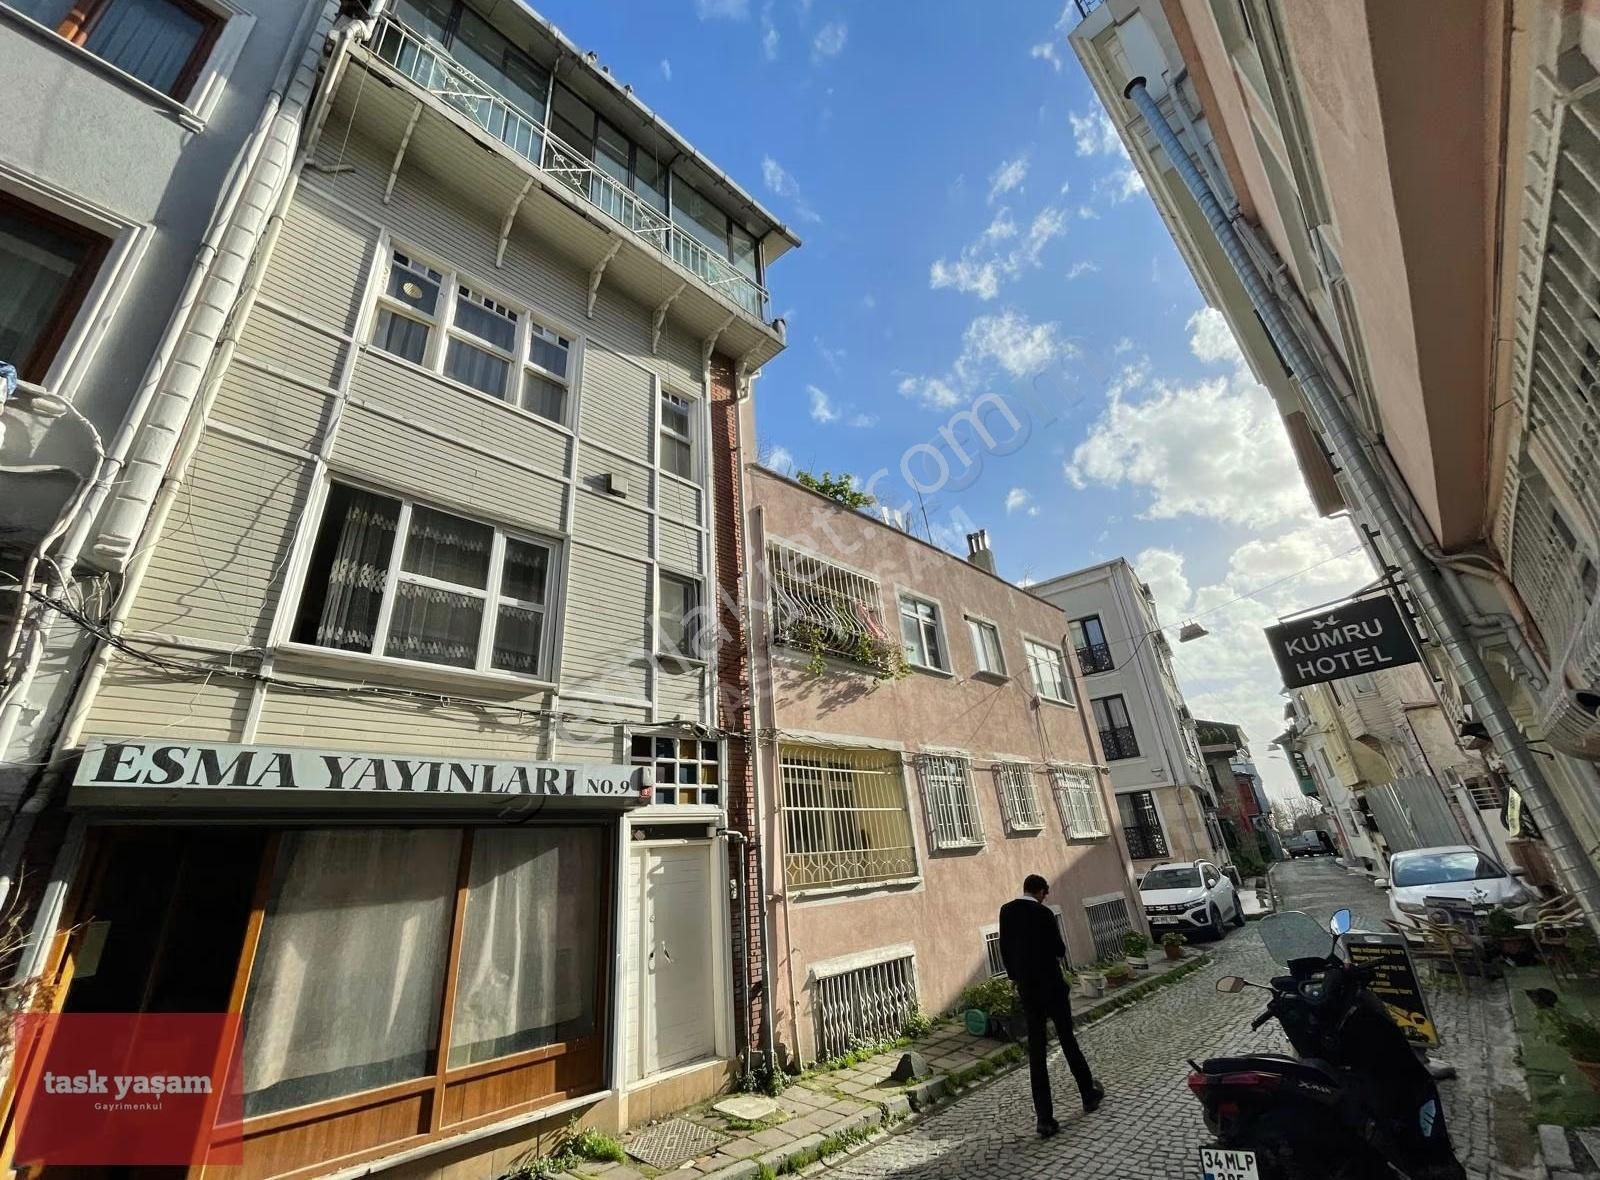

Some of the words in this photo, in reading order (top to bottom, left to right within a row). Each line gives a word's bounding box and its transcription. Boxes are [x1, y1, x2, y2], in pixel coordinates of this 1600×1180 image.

[1284, 618, 1383, 656] KUMRU
[1296, 646, 1392, 679] HOTEL
[91, 743, 299, 788] ESMA
[322, 756, 577, 796] YAYINLARI
[587, 779, 630, 794] NO.9
[1204, 1151, 1223, 1169] 34
[1225, 1153, 1253, 1171] MLP
